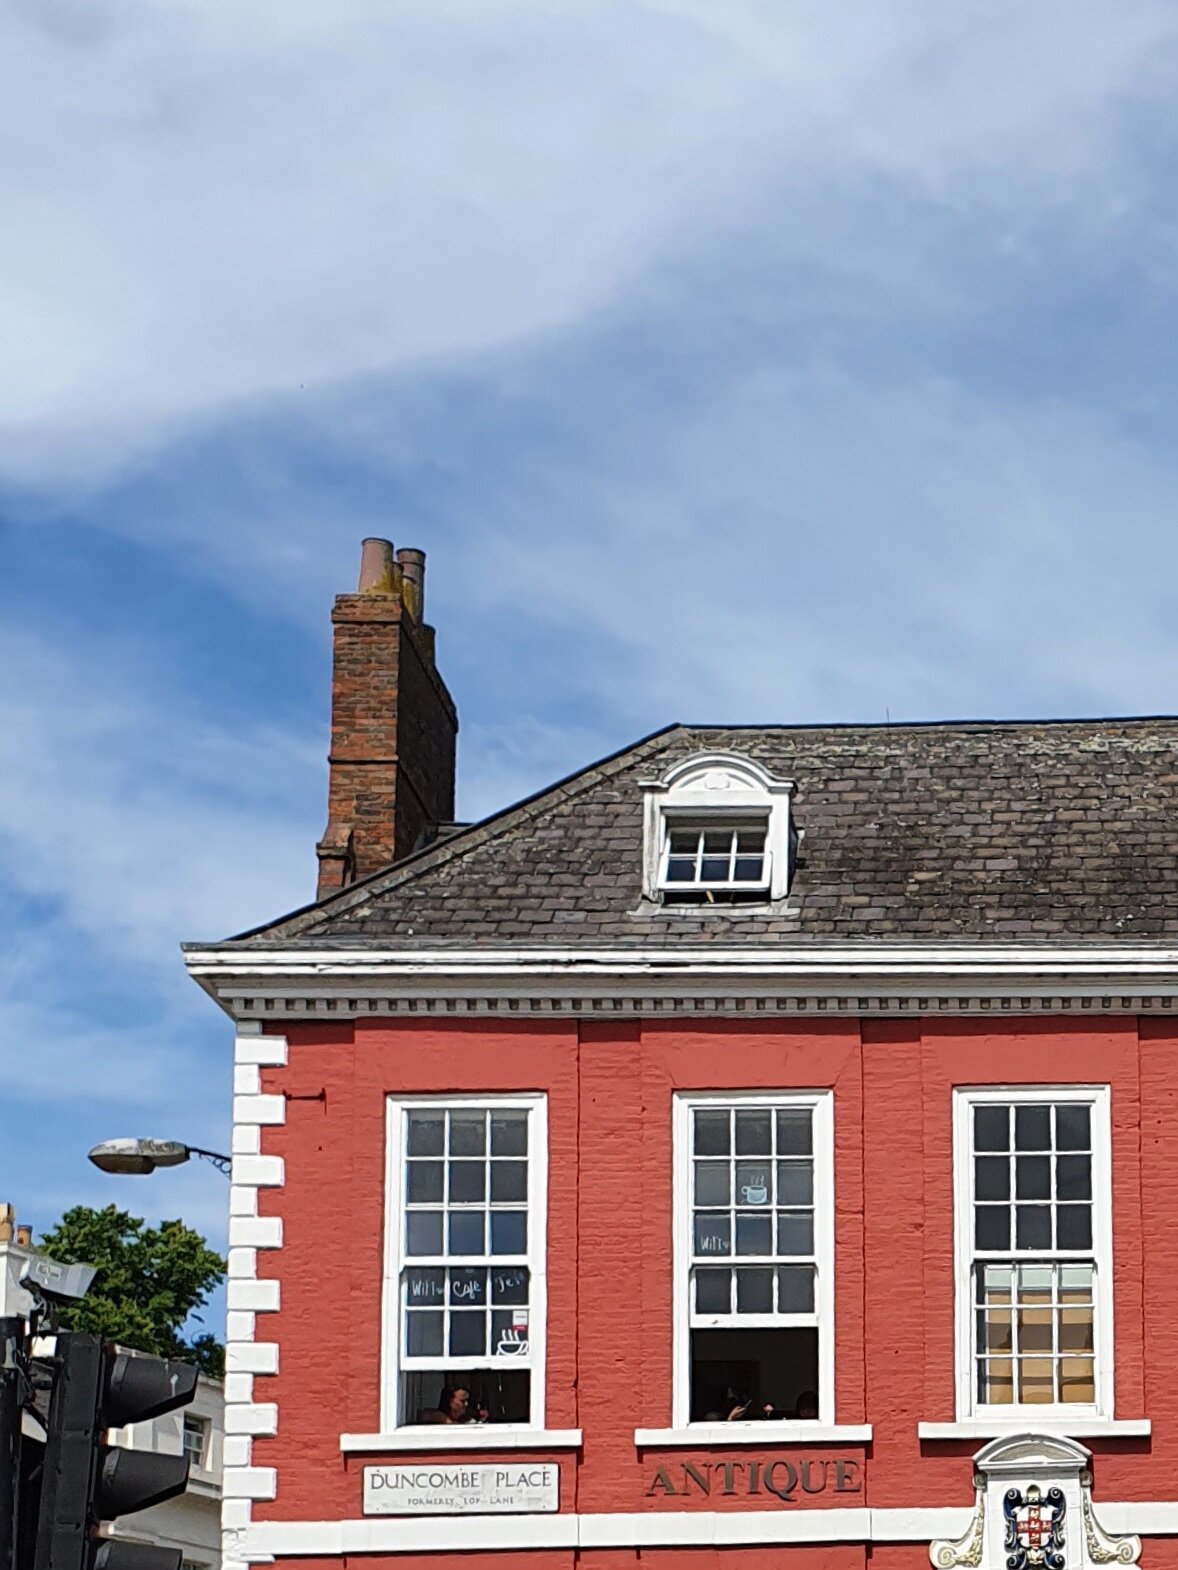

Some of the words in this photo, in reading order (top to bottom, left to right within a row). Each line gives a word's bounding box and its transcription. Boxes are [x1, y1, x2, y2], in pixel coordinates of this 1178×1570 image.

[371, 1472, 480, 1490] DUNCOMBE
[496, 1471, 552, 1488] PLACE
[645, 1459, 862, 1502] ANTIQUE
[408, 1497, 454, 1506] FORMERLY
[490, 1496, 514, 1504] LANE
